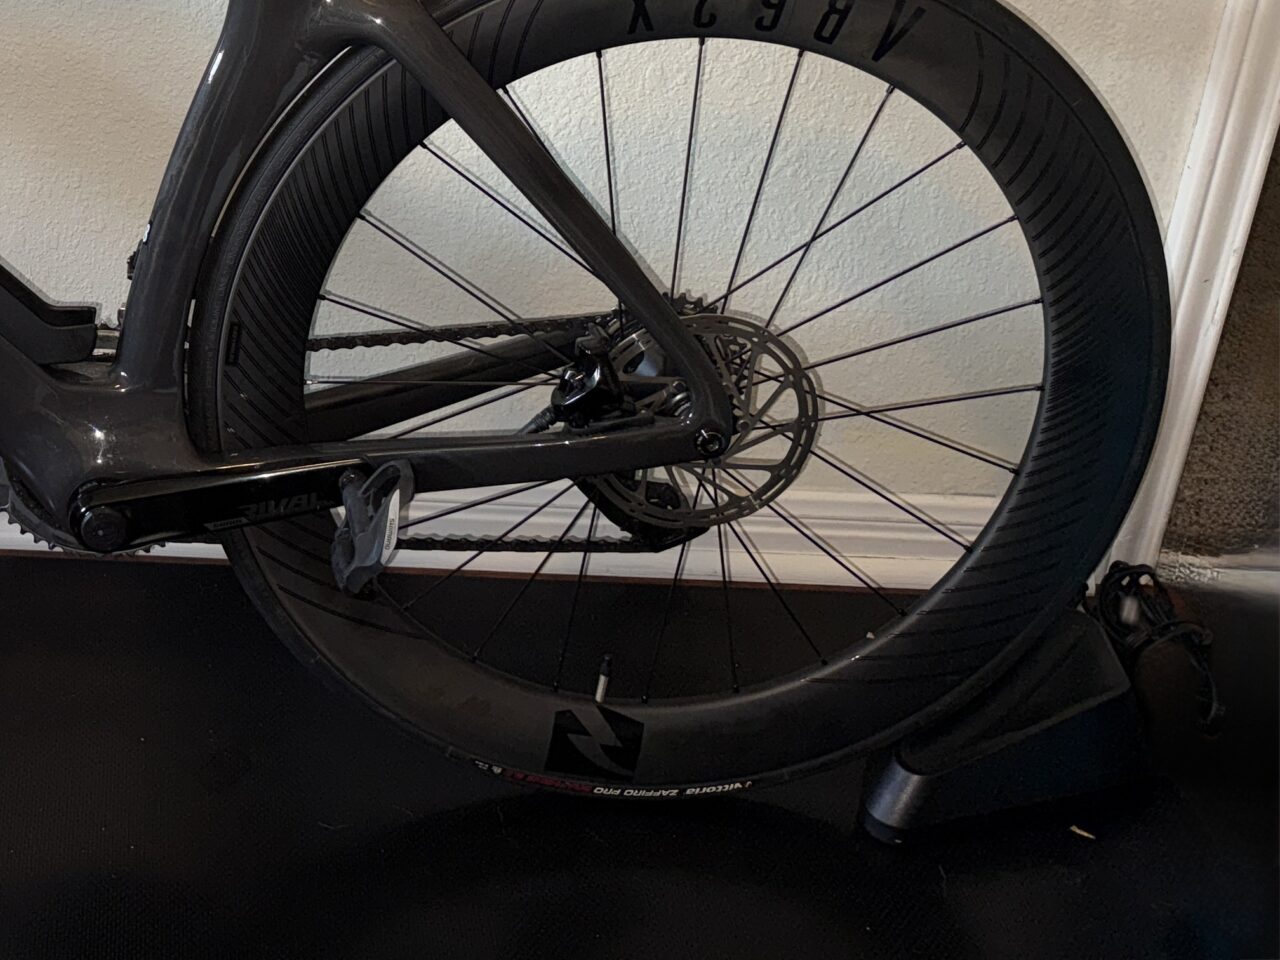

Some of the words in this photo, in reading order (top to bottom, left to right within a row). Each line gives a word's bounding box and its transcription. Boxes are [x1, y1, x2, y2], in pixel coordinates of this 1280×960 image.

[592, 786, 622, 796] PRO
[622, 788, 679, 797] ZAFFIRO
[685, 782, 743, 795] vittoria
